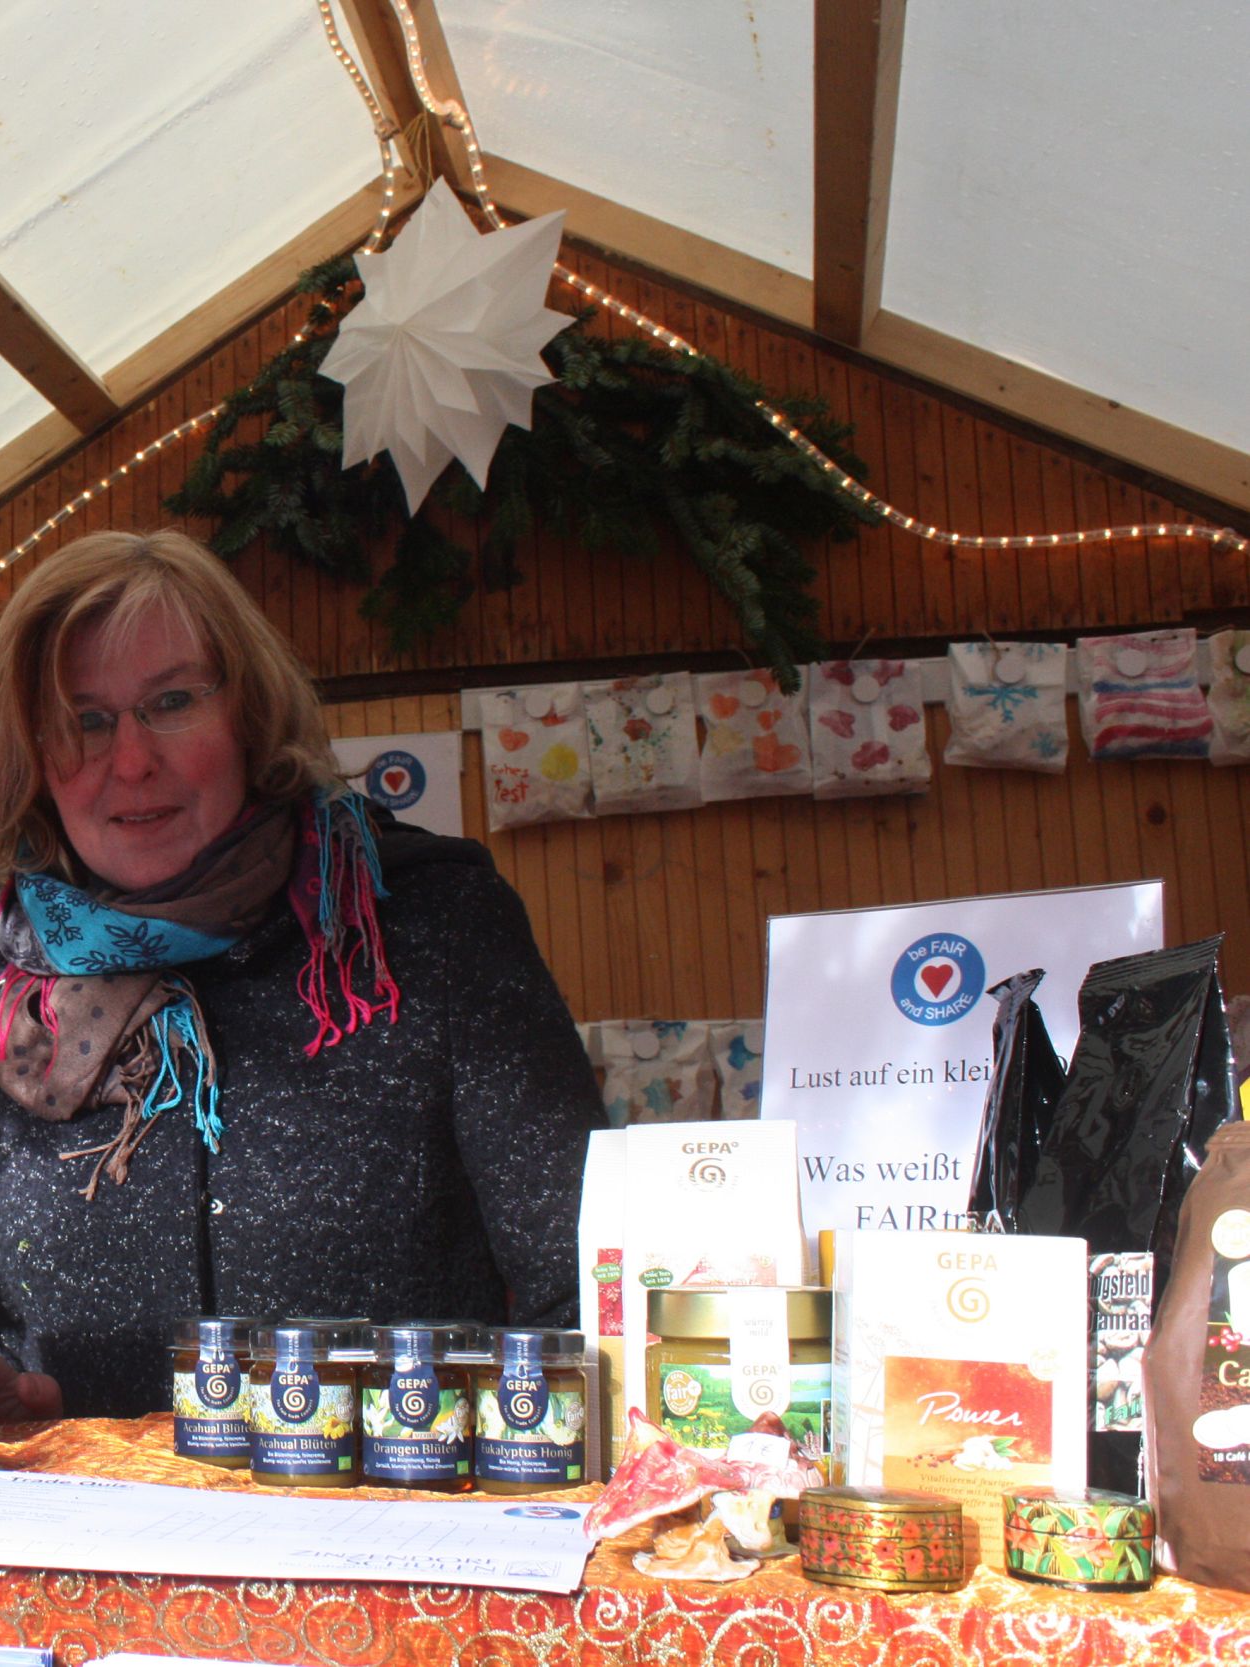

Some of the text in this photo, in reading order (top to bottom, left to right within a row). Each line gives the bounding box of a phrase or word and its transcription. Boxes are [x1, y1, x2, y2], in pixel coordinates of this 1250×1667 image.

[907, 940, 967, 961] be FAIR
[900, 993, 974, 1020] and SHARE
[789, 1058, 993, 1090] Lust auf ein klei
[803, 1153, 962, 1184] Was weißt
[855, 1205, 968, 1231] FAIRtr
[936, 1251, 999, 1272] GEPA
[742, 1365, 778, 1376] GEPA
[1218, 1360, 1250, 1388] Ca
[917, 1391, 1023, 1427] Power
[183, 1422, 250, 1434] Acahual Blüte
[259, 1438, 337, 1450] Acahual Blüten
[374, 1442, 457, 1457] Orangen Blüten
[481, 1443, 573, 1460] Eukalyptus Honig
[1213, 1452, 1225, 1463] 18
